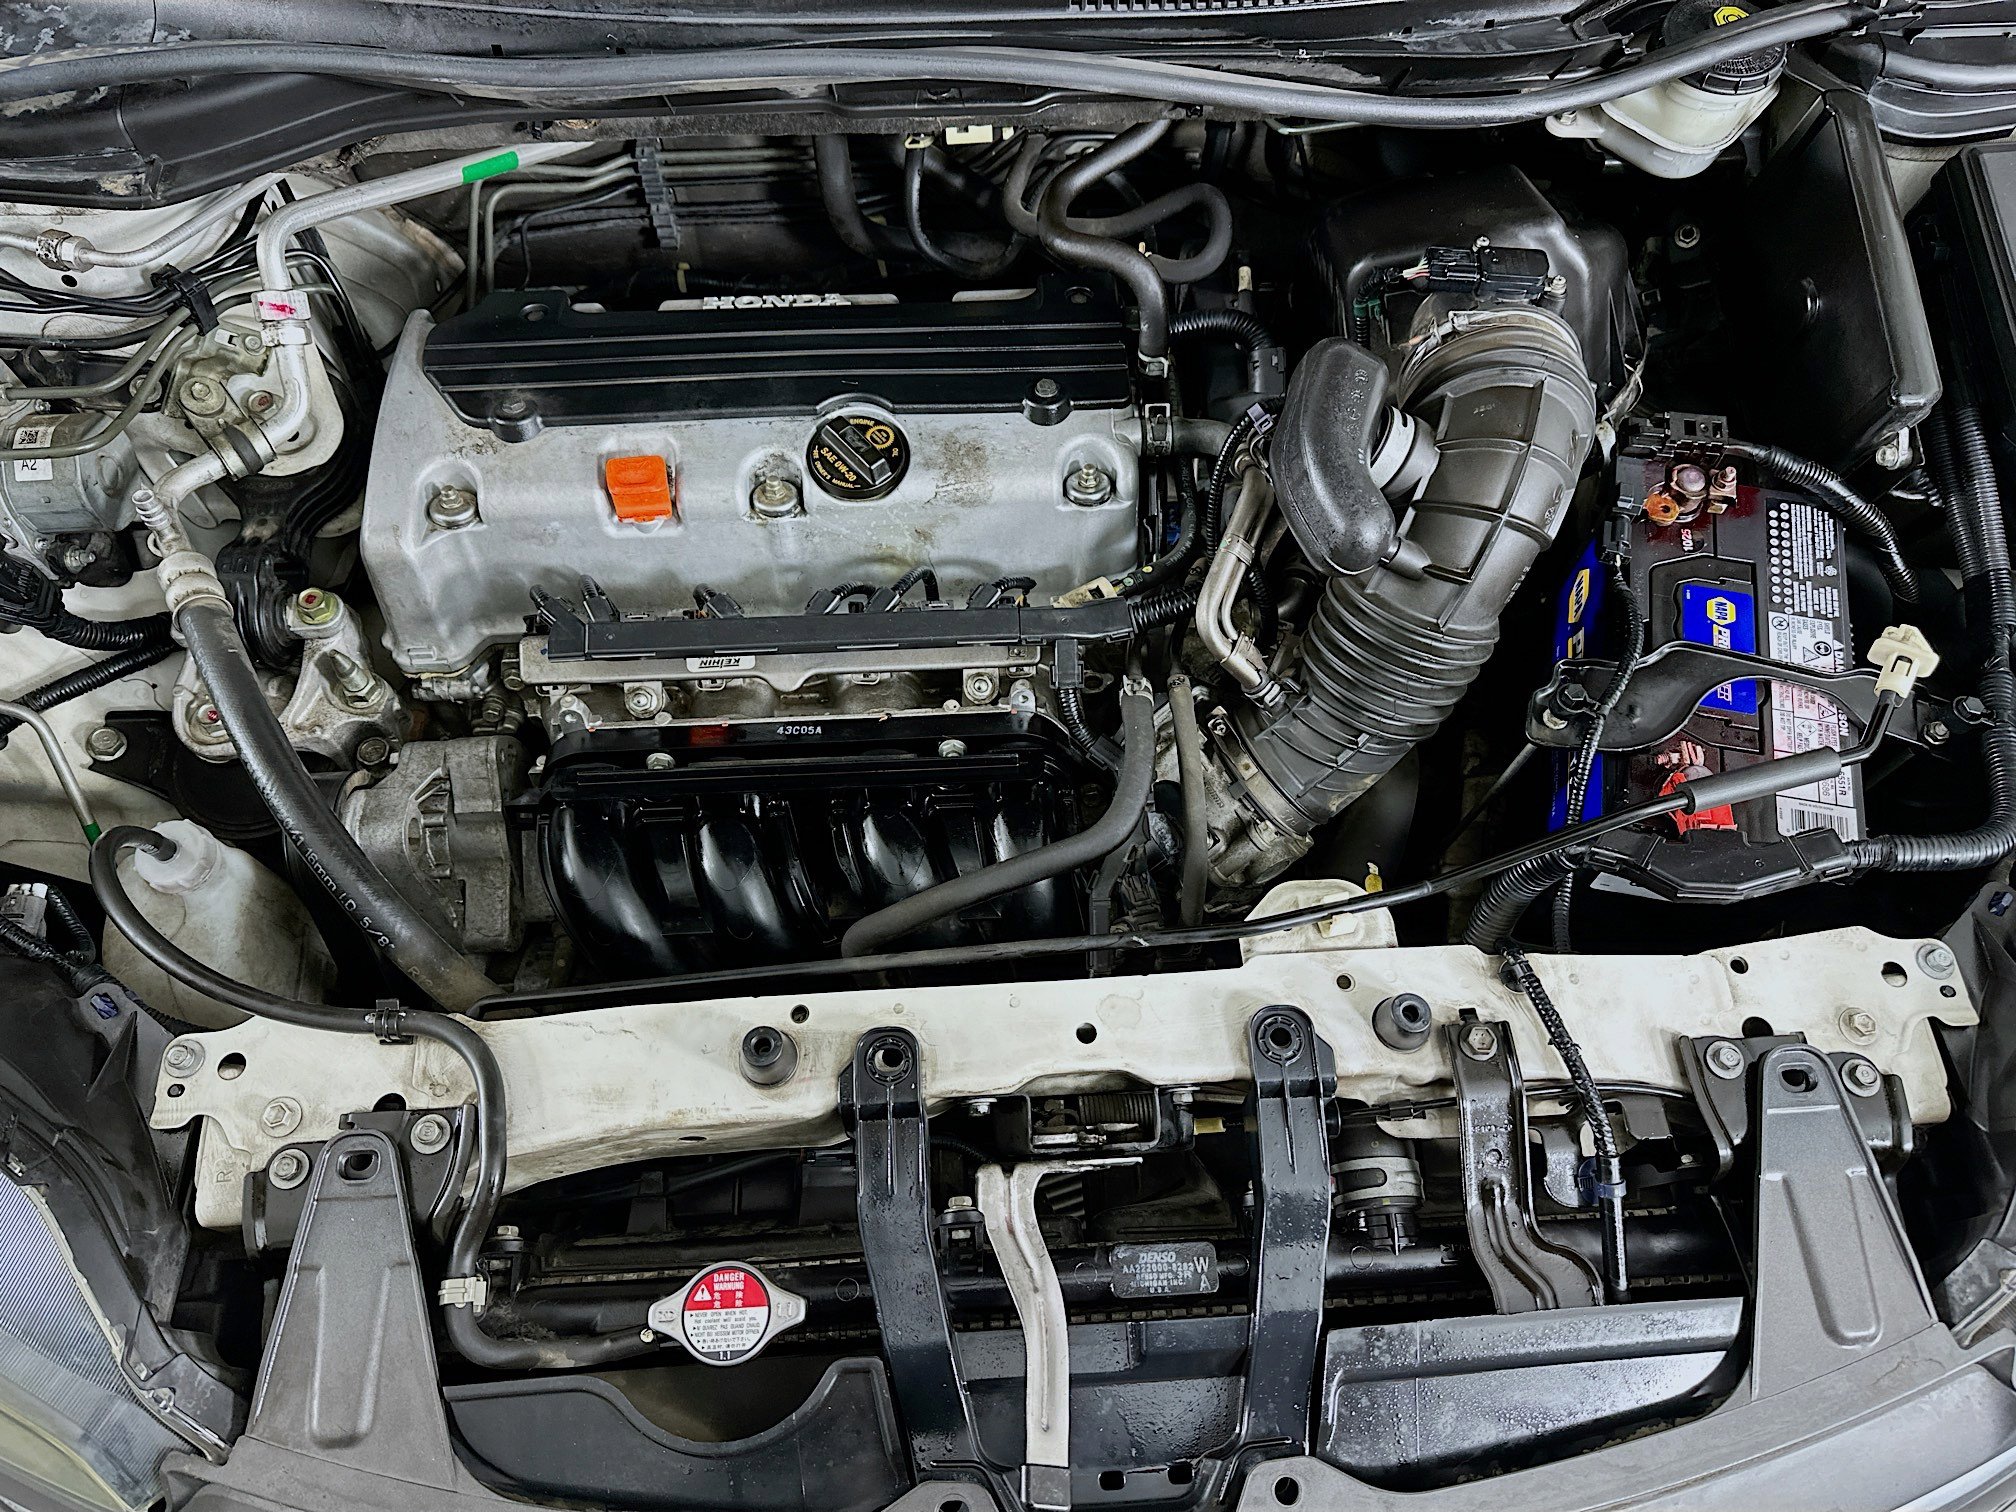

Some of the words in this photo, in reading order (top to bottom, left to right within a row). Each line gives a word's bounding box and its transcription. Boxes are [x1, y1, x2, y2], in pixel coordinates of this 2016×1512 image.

[703, 293, 851, 309] HONDA
[850, 418, 875, 426] ENGINE
[820, 447, 837, 463] SAE
[834, 460, 857, 481] 0W-20
[832, 478, 855, 488] MANUAL
[1715, 601, 1728, 620] NAPA
[699, 658, 740, 668] KEIHIN
[777, 726, 822, 735] 43C05A
[1139, 1252, 1176, 1264] DENSO
[1194, 1256, 1209, 1274] W
[714, 1272, 745, 1282] DANGER
[714, 1282, 744, 1291] WARNUNG
[1200, 1274, 1211, 1292] A
[720, 1351, 731, 1360] 1.1
